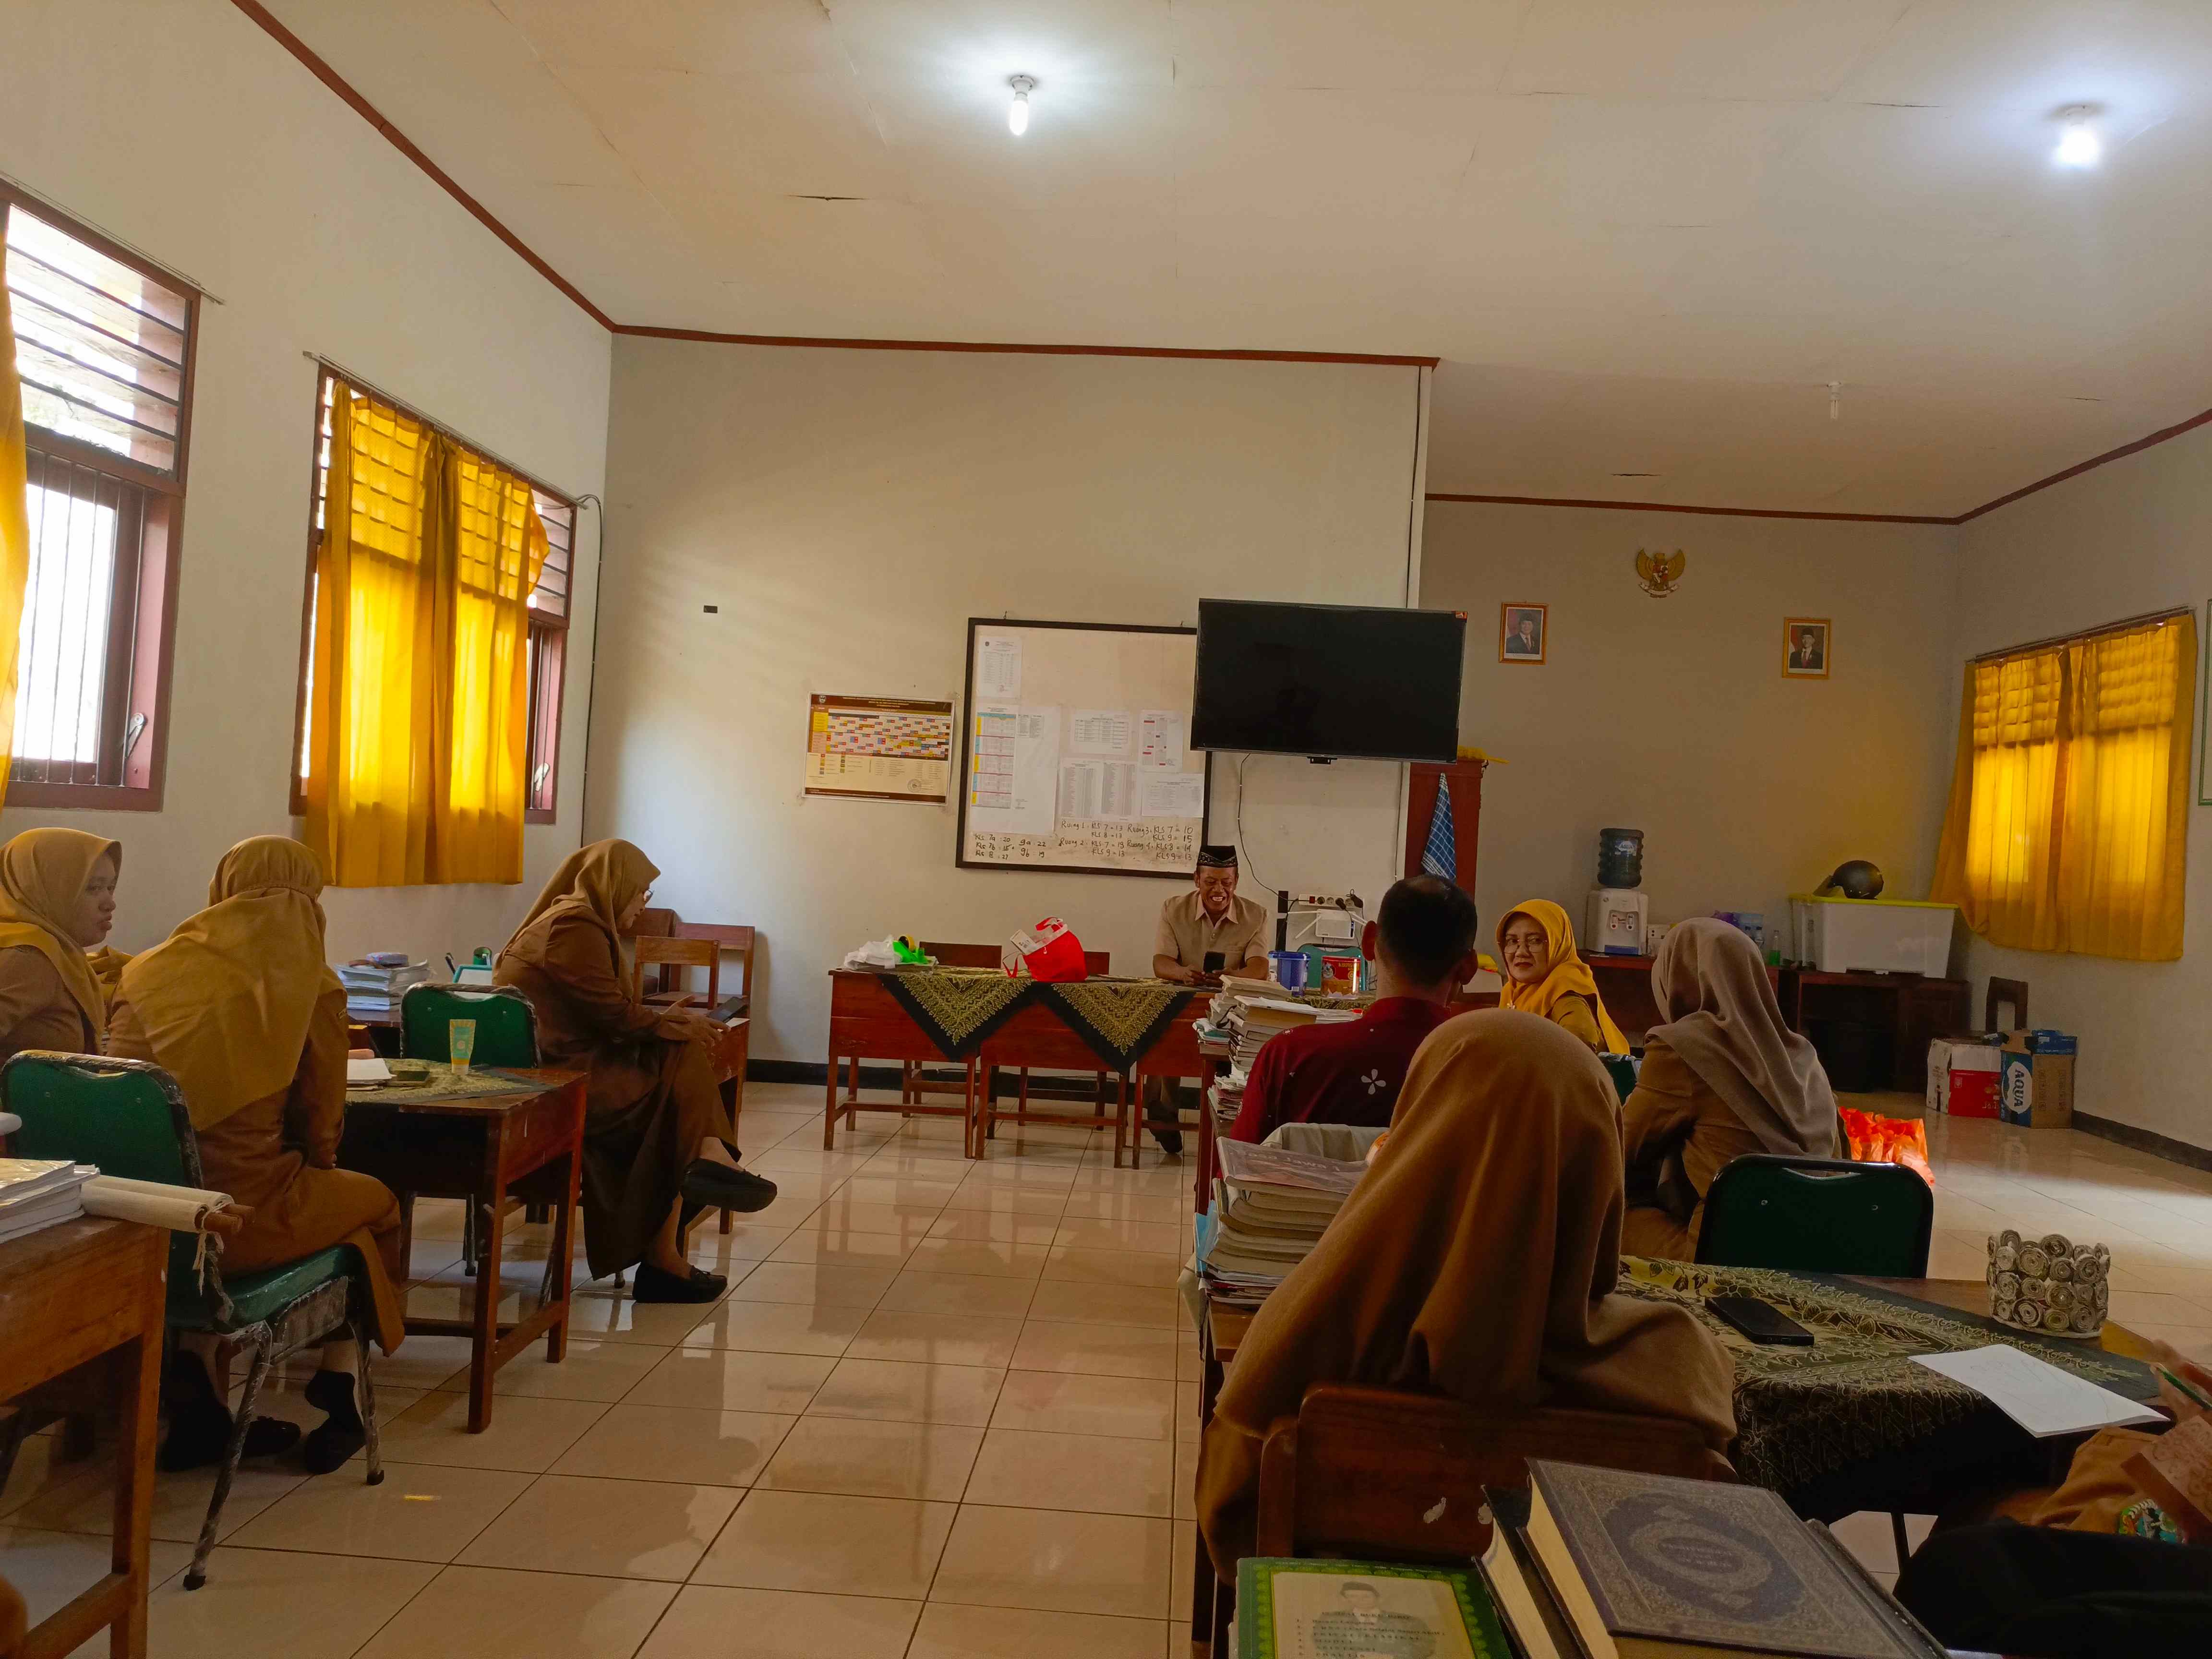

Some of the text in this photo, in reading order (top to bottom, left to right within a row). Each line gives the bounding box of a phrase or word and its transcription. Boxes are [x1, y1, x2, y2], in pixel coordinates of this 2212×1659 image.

[1154, 825, 1165, 834] KLS
[1167, 826, 1173, 834] 7
[1184, 826, 1193, 834] 10
[1183, 835, 1193, 843] 15
[1092, 847, 1104, 855] KLS
[1106, 849, 1110, 857] 9
[1156, 842, 1167, 851] KLS
[1169, 842, 1174, 851] 8
[1184, 844, 1192, 853] 14
[1156, 852, 1169, 860] KLS
[2012, 1068, 2024, 1106] AQUA
